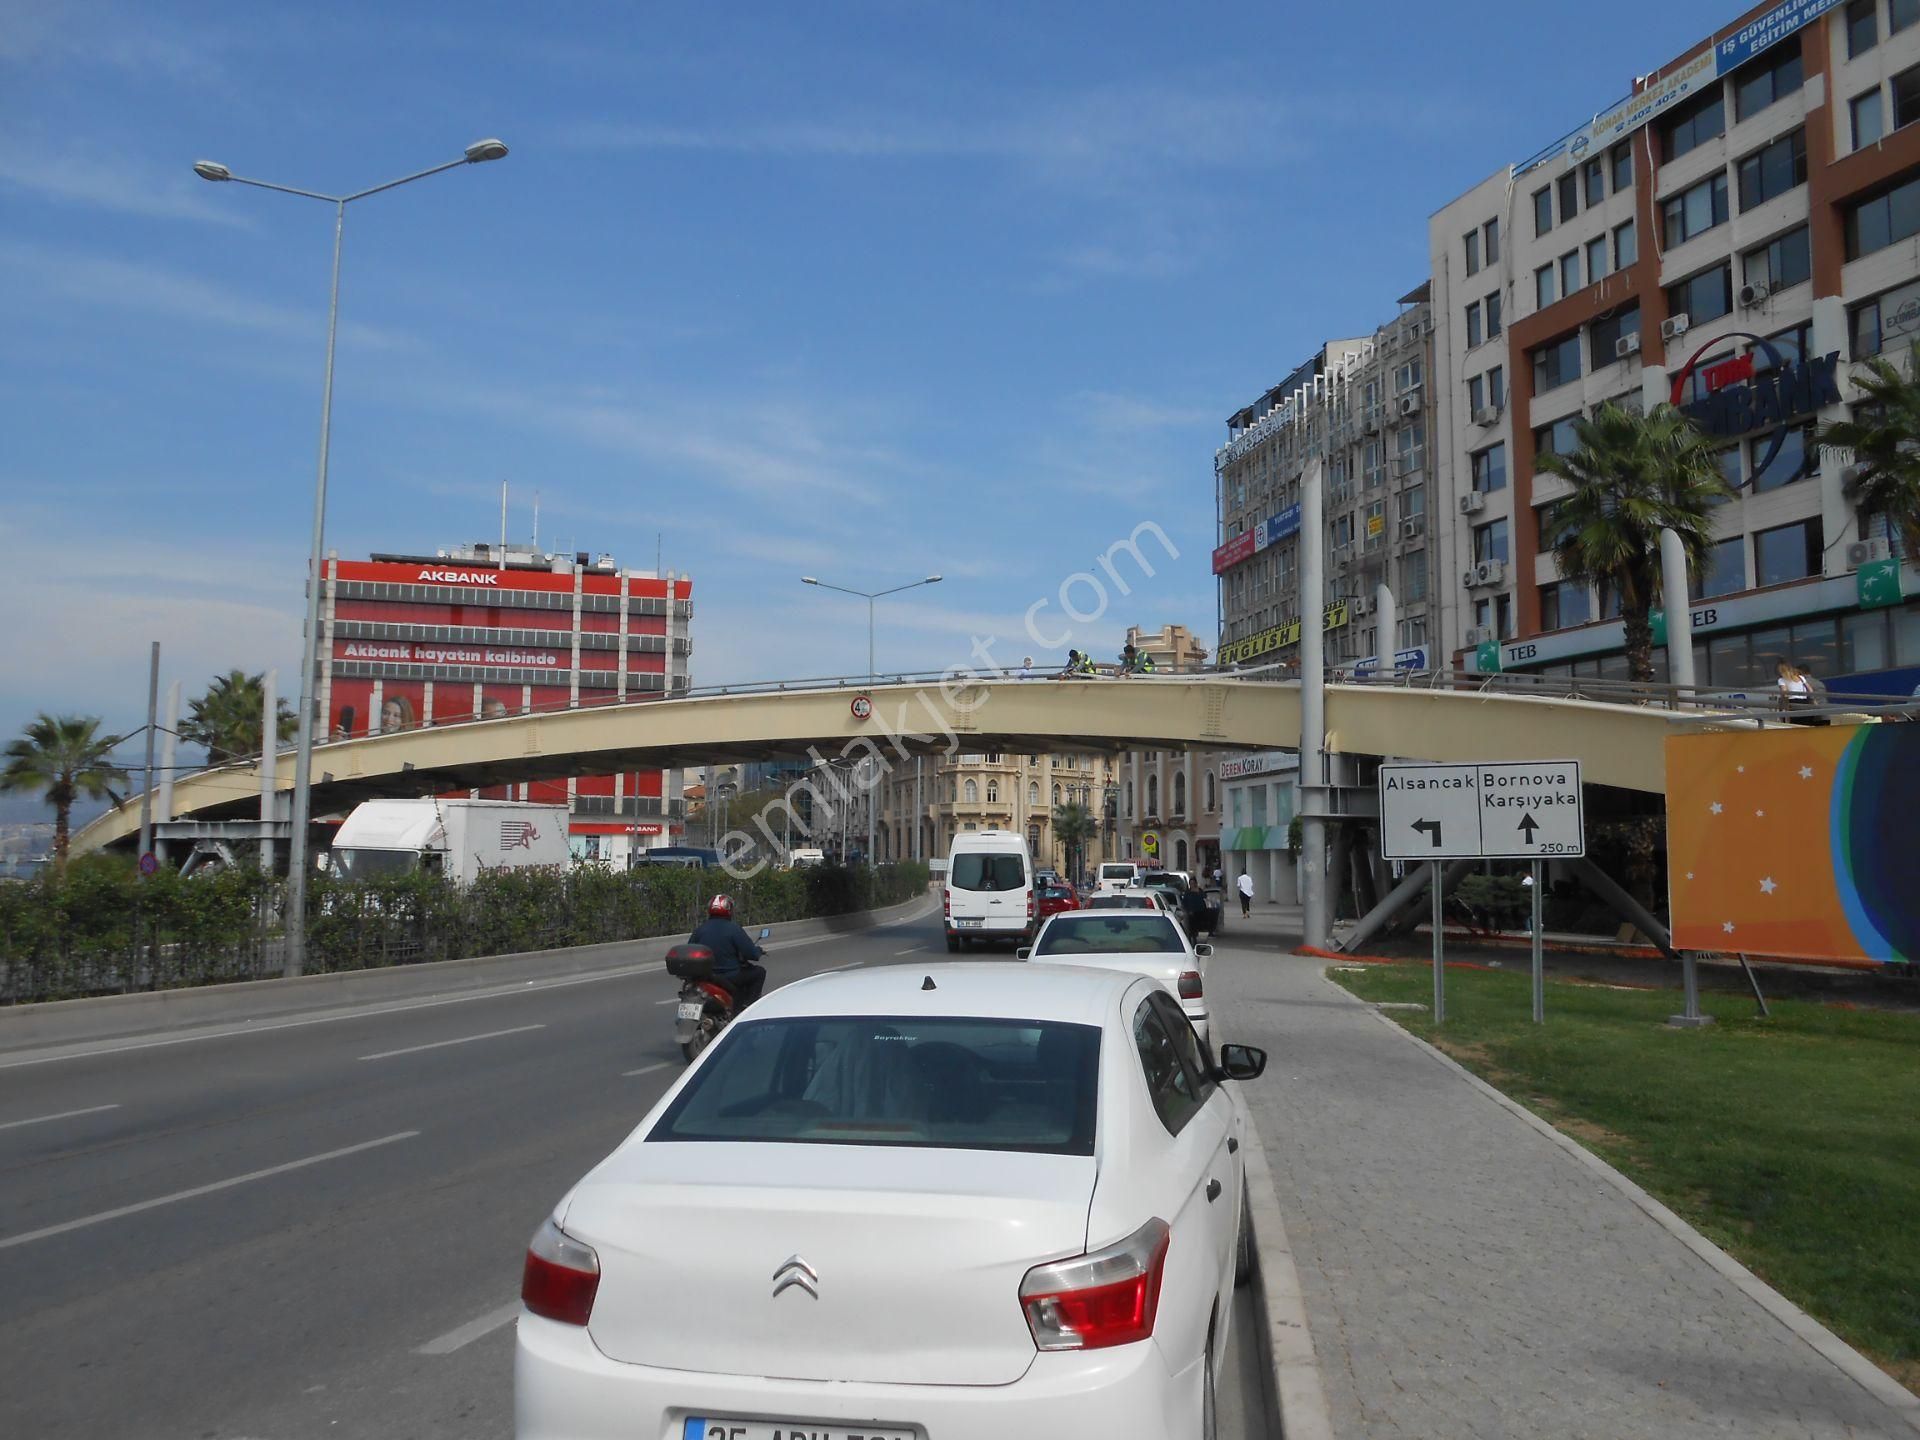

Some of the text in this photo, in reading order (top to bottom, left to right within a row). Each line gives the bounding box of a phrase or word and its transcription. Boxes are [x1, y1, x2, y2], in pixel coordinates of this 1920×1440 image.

[1751, 15, 1799, 52] EĞİTİM
[1722, 40, 1735, 54] İŞ
[1655, 90, 1676, 107] 402
[418, 570, 498, 585] AKBANK
[1688, 608, 1718, 628] EB
[1220, 627, 1290, 664] ENGLISH
[1508, 644, 1537, 662] TEB
[344, 643, 556, 666] Akbank hayatın kalbinde
[1386, 774, 1475, 791] Alsancak
[1483, 773, 1567, 788] Bornova
[1484, 791, 1577, 810] Karşıyaka
[1539, 843, 1579, 853] 250 m
